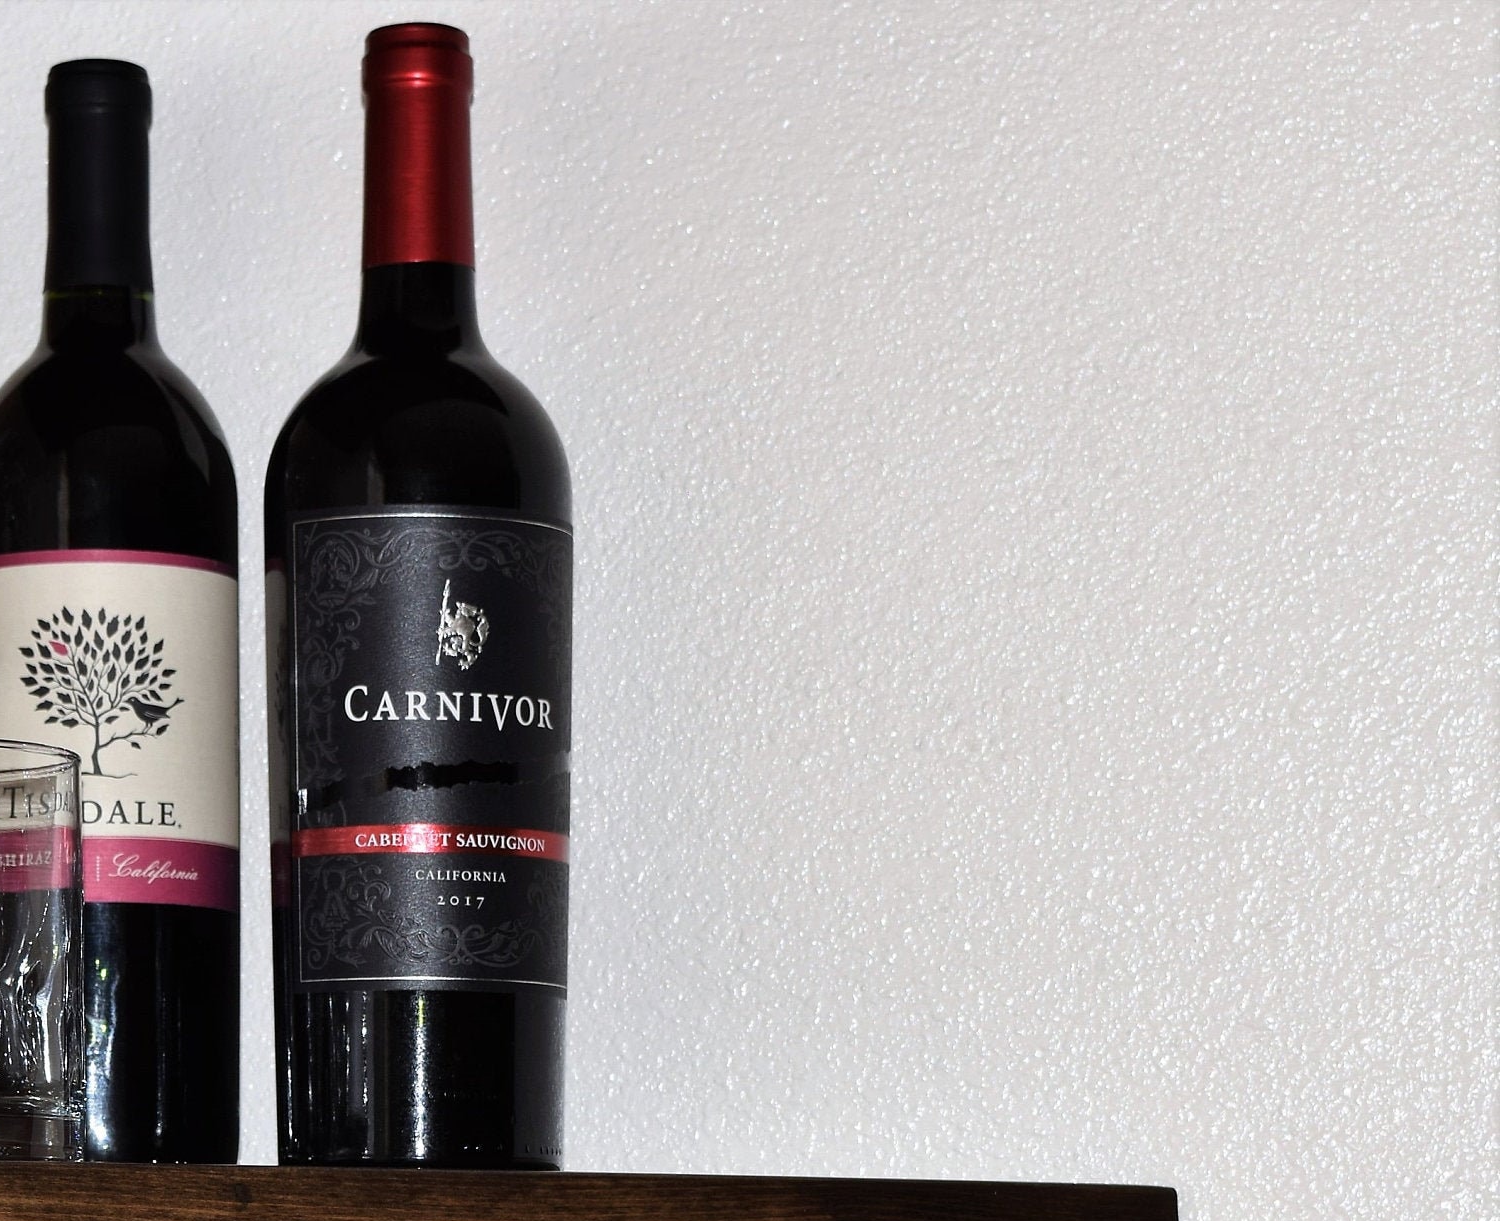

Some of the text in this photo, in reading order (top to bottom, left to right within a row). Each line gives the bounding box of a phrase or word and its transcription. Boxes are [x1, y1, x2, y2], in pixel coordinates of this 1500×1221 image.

[344, 685, 553, 731] CARNIVOR
[456, 833, 545, 852] SAUVIGNON
[108, 852, 200, 884] California
[415, 869, 506, 883] CALIFORNIA
[437, 895, 485, 909] 2017
